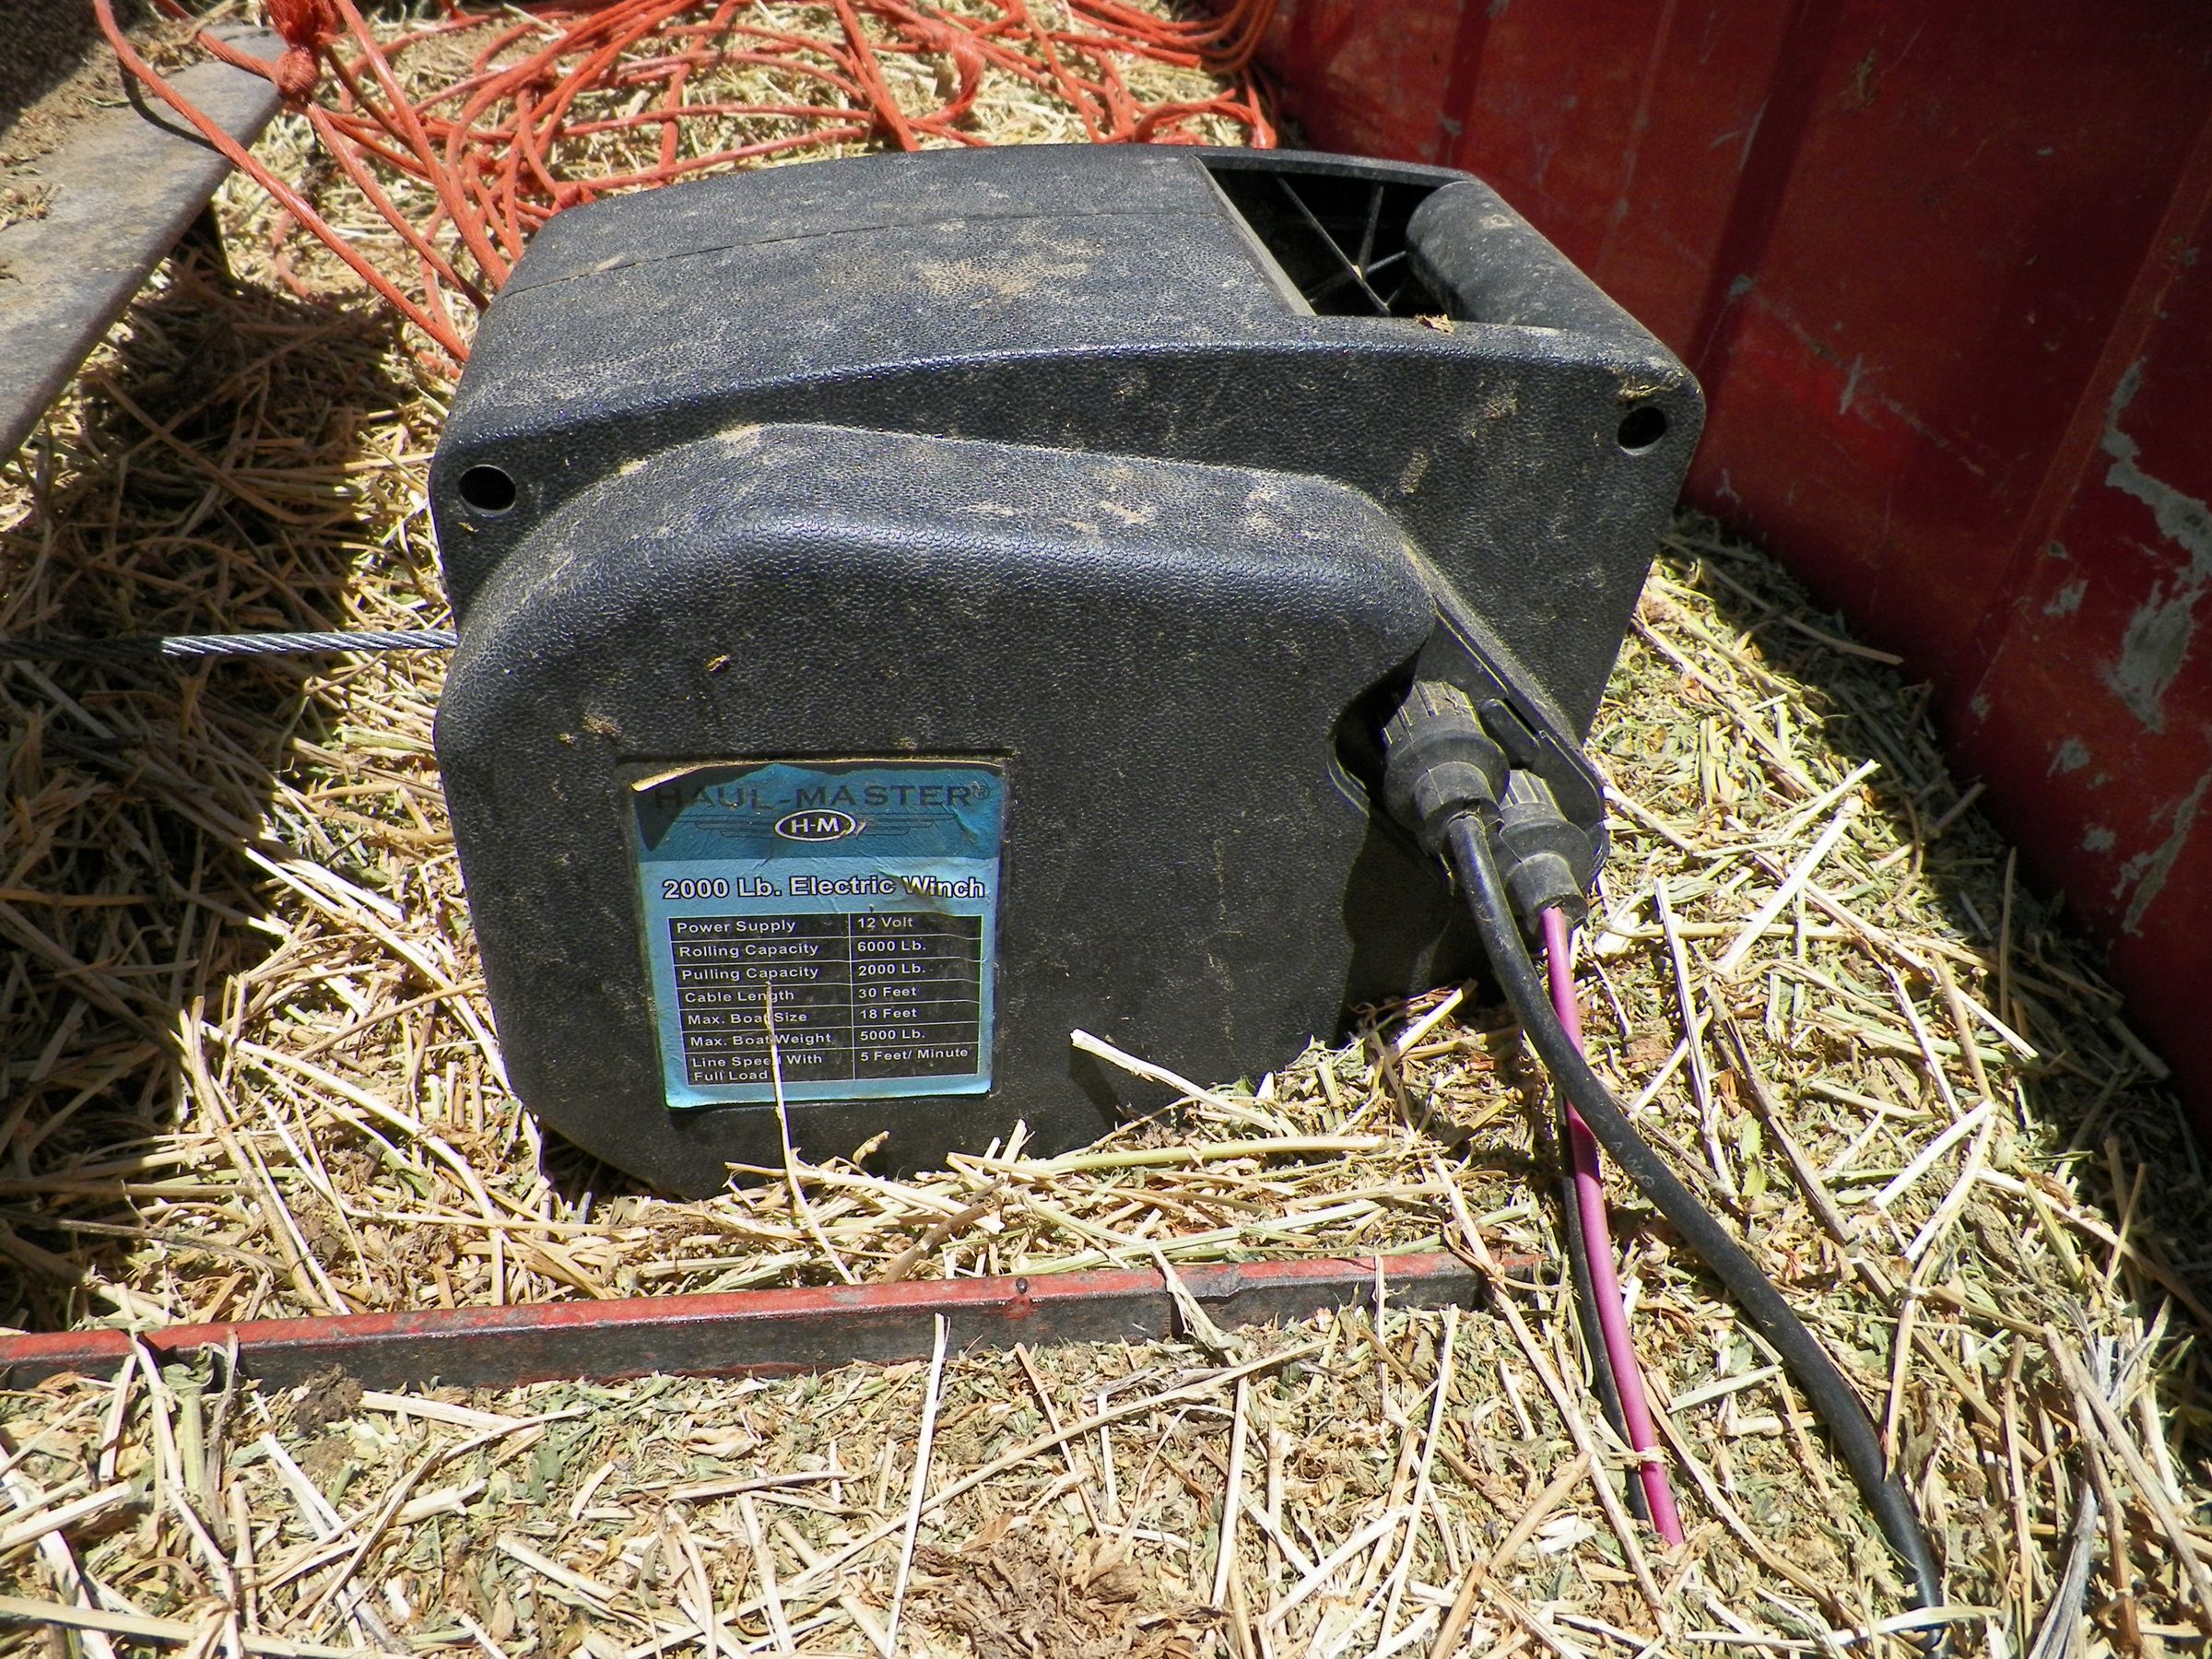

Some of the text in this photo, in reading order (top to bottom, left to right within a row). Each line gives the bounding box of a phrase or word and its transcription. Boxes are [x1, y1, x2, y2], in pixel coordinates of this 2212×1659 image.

[791, 817, 841, 835] H-M
[662, 874, 986, 900] 2000 Lb. Electric Winch
[677, 920, 796, 934] Power Supply
[857, 916, 913, 929] 12 Volt
[679, 943, 819, 959] Rolling Capacity
[857, 940, 926, 952] 6000 Lb.
[682, 967, 819, 982] Pulling Capacity
[858, 963, 926, 977] 2000 Lb.
[685, 990, 794, 1004] Cable Length
[858, 986, 917, 999] 30 Feet
[688, 1014, 725, 1025] Max.
[774, 1012, 807, 1023] Size
[860, 1007, 917, 1019] 18 Feet
[690, 1036, 727, 1047] Max.
[775, 1033, 831, 1046] Weight
[860, 1029, 926, 1041] 5000 Lb.
[692, 1056, 726, 1067] Line
[786, 1053, 822, 1065] With
[861, 1051, 869, 1062] 5
[917, 1048, 969, 1060] Minute
[694, 1070, 768, 1082] Full Load
